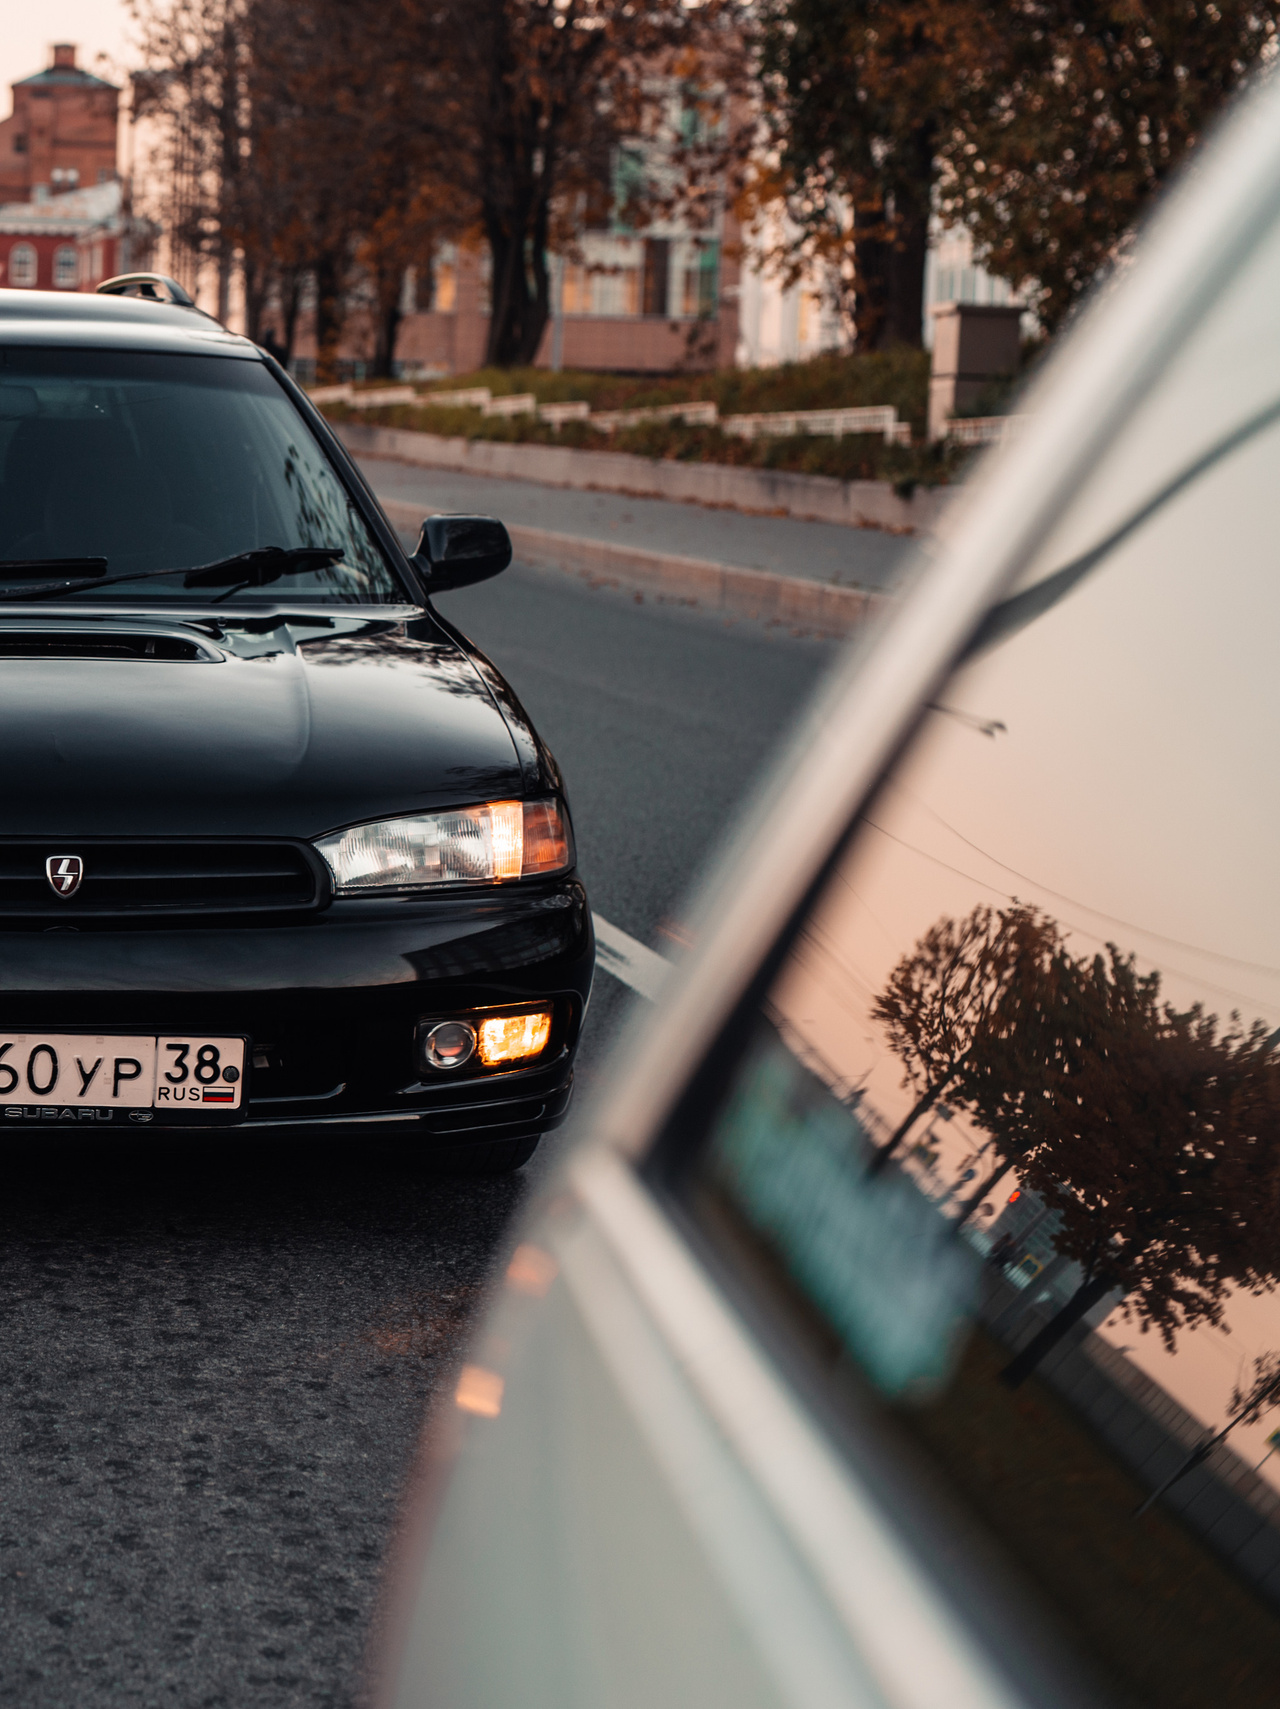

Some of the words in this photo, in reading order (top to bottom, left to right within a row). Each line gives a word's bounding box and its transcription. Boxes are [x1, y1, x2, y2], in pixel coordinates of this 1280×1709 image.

[164, 1043, 221, 1085] 38
[158, 1086, 201, 1102] RUS
[4, 1106, 114, 1121] SUBARU
